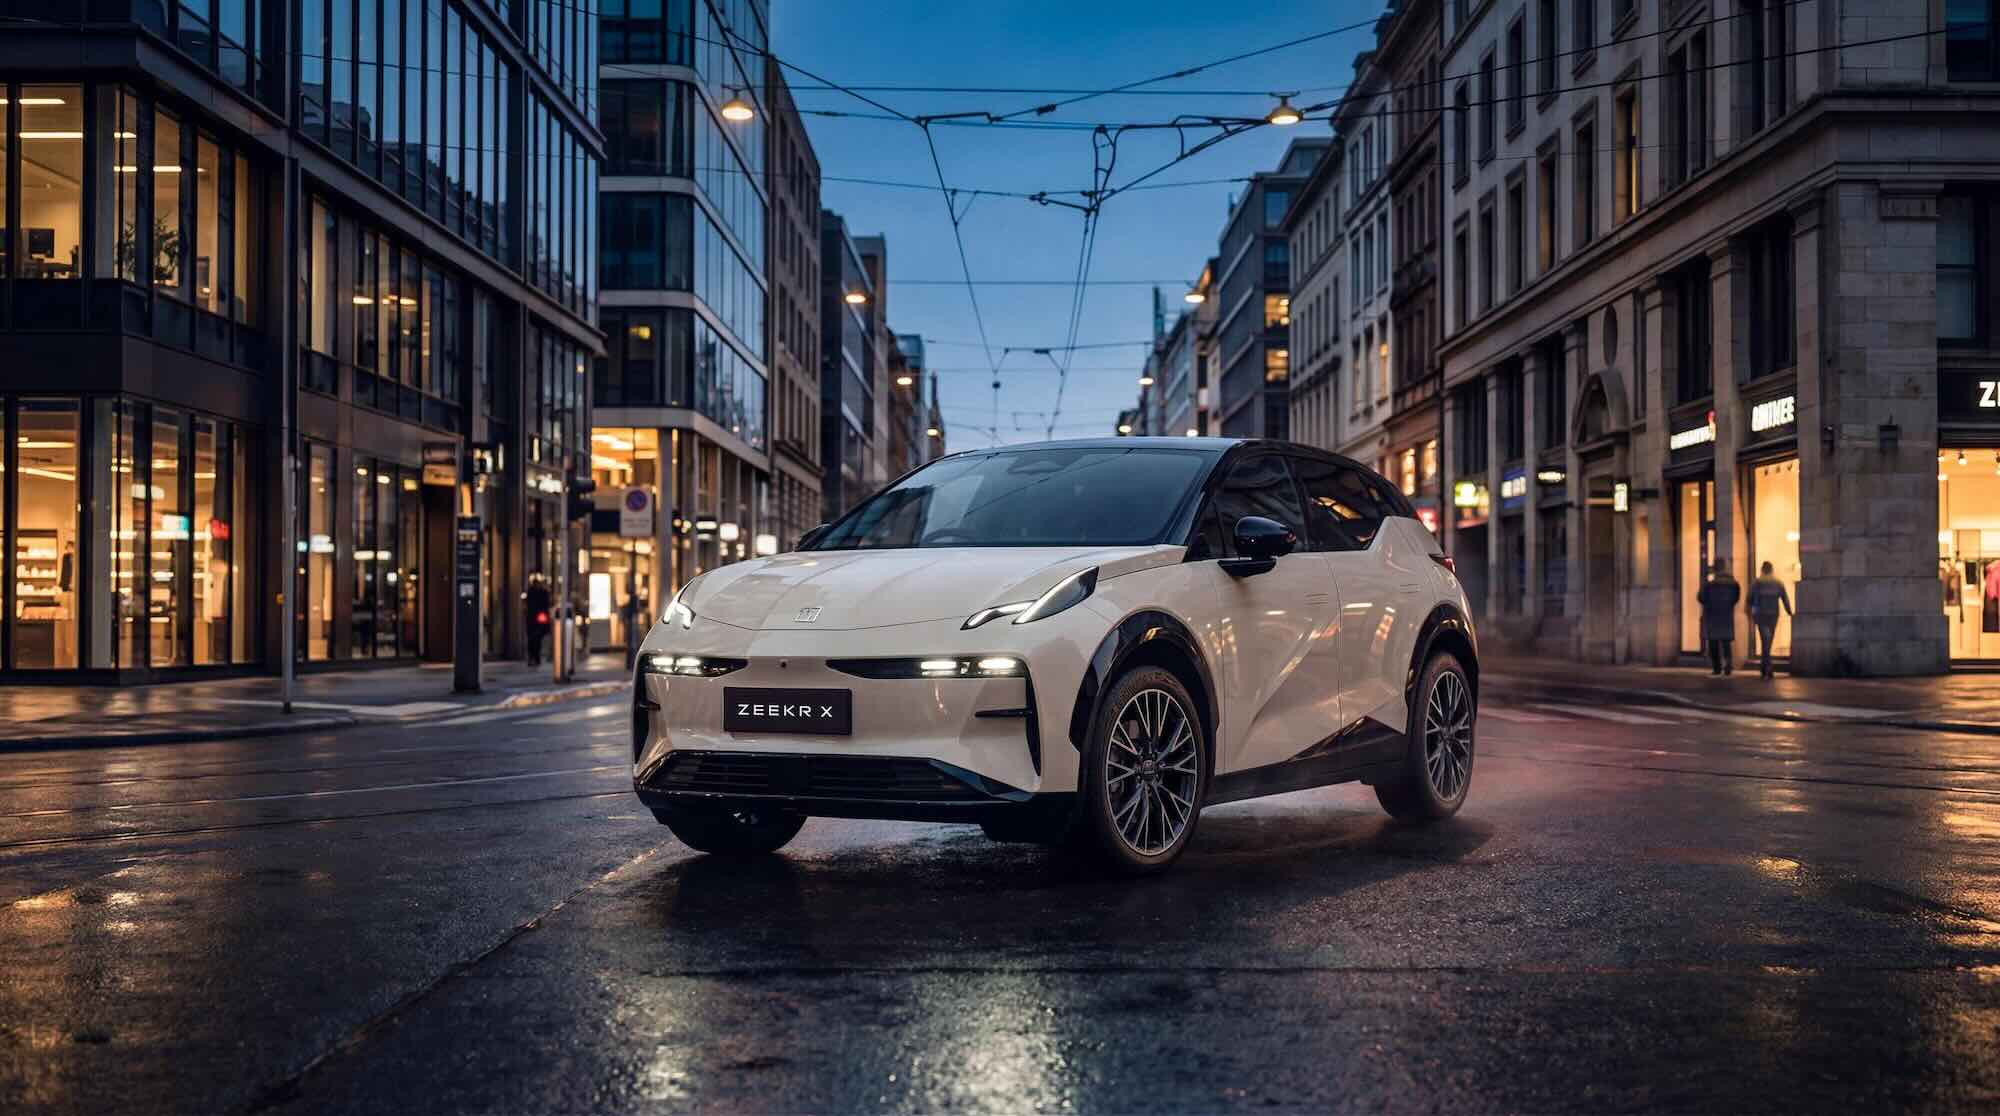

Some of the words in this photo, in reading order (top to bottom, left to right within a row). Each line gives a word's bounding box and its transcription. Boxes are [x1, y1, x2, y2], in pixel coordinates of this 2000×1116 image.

[1979, 381, 2000, 407] Z
[738, 704, 811, 717] ZEEKR
[820, 706, 832, 718] X
